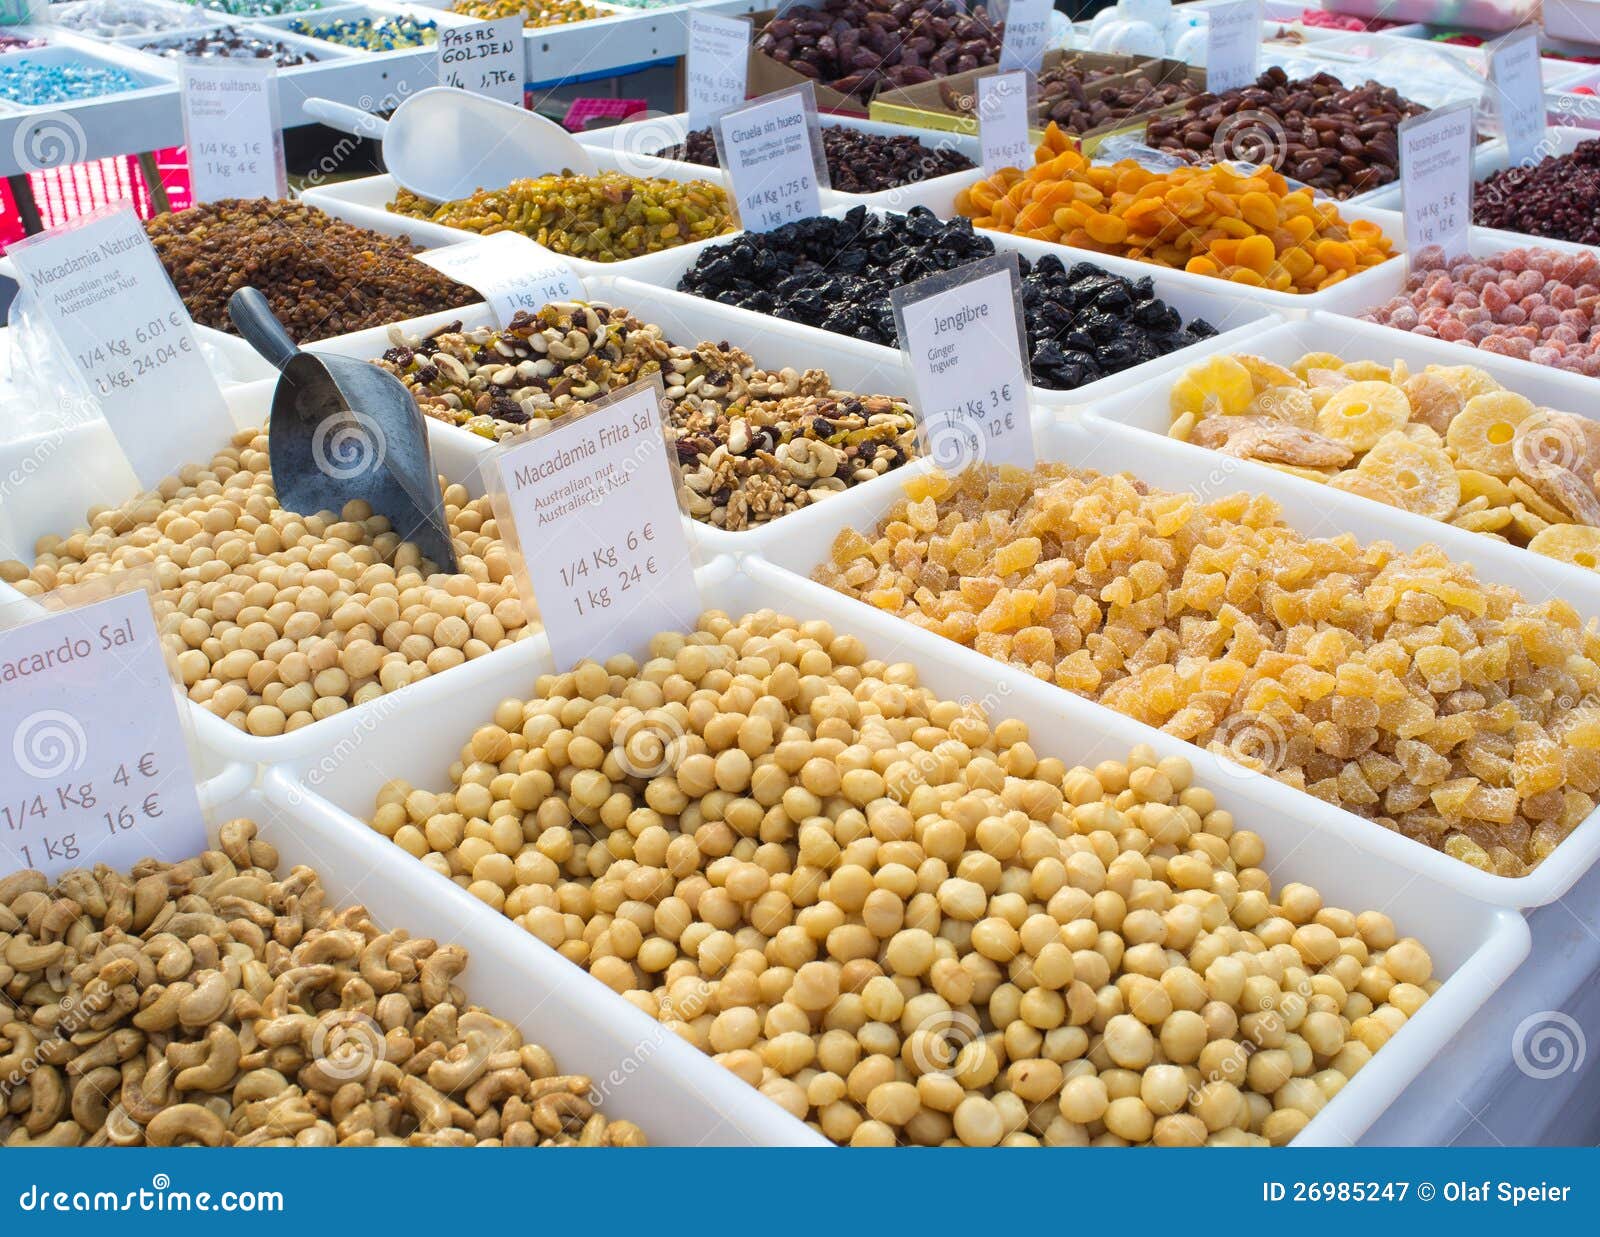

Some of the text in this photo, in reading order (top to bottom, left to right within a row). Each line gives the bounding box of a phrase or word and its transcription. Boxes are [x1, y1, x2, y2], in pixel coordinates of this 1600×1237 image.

[442, 40, 513, 63] GOLDEN
[190, 79, 262, 92] Pasas sultanas
[732, 114, 802, 143] Ciruela sin hueso
[200, 143, 217, 156] 1/4
[221, 143, 237, 158] Kg
[252, 143, 261, 155] €
[216, 162, 232, 177] kg
[237, 162, 246, 174] 4
[249, 162, 257, 174] €
[747, 176, 809, 210] 1/4 Kg 1.75 €
[769, 211, 782, 225] kg
[786, 204, 792, 216] 7
[795, 200, 802, 213] €
[1416, 206, 1428, 221] 1/4
[1429, 202, 1439, 216] Kg
[1449, 192, 1456, 206] €
[1448, 214, 1455, 228] €
[30, 231, 146, 289] Macadamia Natural
[54, 269, 120, 305] Australian nut
[60, 275, 138, 317] Australische Nut
[507, 282, 569, 308] 1 kg 14 €
[934, 303, 989, 336] Jengibre
[79, 311, 182, 370] 1/4 Kg 6.01 €
[927, 342, 955, 361] Ginger
[95, 377, 106, 393] 1
[133, 344, 177, 376] 24.04
[179, 336, 192, 352] €
[929, 354, 959, 375] Ingwer
[944, 384, 1012, 428] 1/4 Kg 3 €
[514, 408, 652, 491] Macadamia Frita Sal
[953, 412, 1015, 455] 1 kg 12 €
[534, 462, 615, 511] Australian nut
[537, 472, 631, 527] Australische Nut
[560, 522, 655, 587] 1/4 Kg 6 €
[574, 556, 658, 616] 1 kg 24 €
[0, 618, 135, 684] acardo Sal
[1, 752, 159, 831] 1/4 Kg 4 €
[20, 793, 164, 868] 1 kg 16 €
